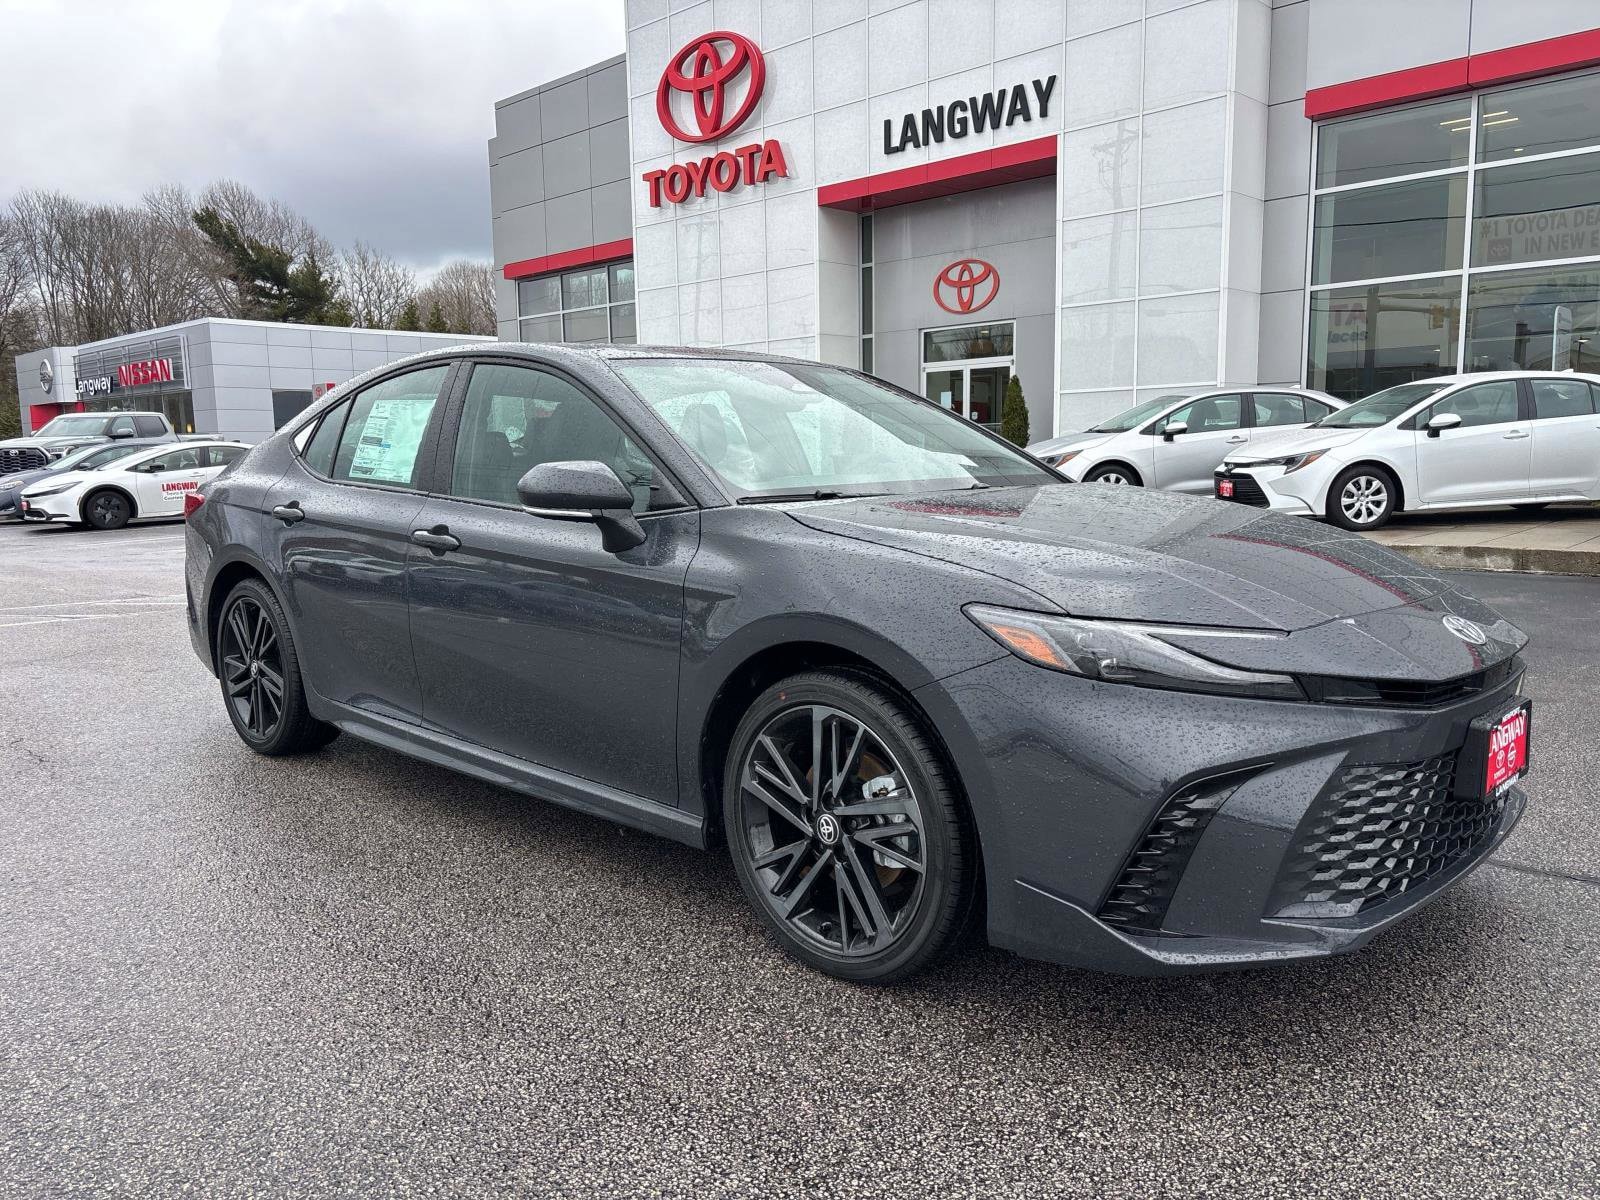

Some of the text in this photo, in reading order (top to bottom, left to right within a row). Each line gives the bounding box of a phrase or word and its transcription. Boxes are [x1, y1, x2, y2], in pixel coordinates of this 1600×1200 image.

[883, 75, 1057, 155] LANGWAY
[642, 139, 788, 208] TOYOTA
[1505, 211, 1567, 236] TOYOTA
[1524, 236, 1542, 255] IN
[1548, 231, 1586, 252] NEW
[75, 358, 174, 395] Langway NISSAN
[162, 481, 199, 492] LANGWAY
[1489, 716, 1525, 756] LANGWAY
